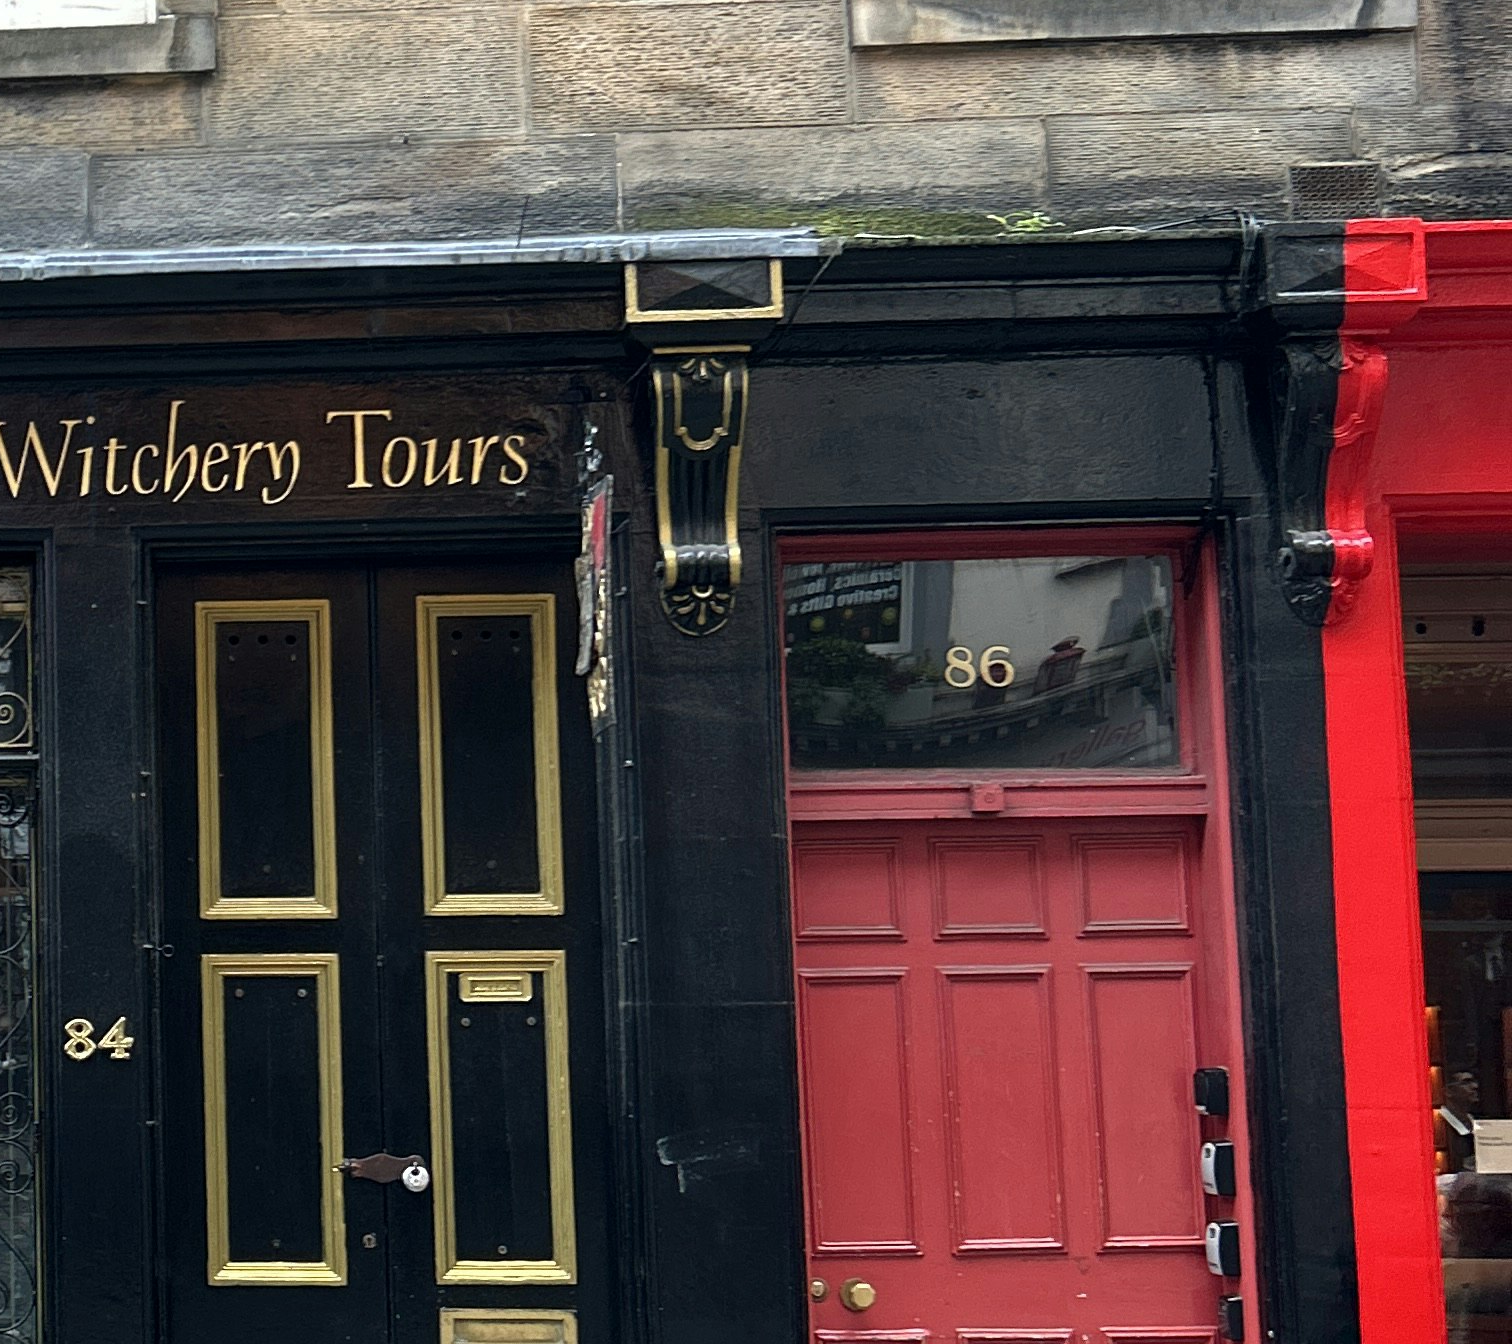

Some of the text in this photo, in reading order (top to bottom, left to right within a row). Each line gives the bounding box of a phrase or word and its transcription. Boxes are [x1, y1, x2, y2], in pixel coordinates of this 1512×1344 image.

[327, 410, 527, 488] Tours
[944, 645, 1016, 688] 86
[63, 1017, 135, 1061] 84
